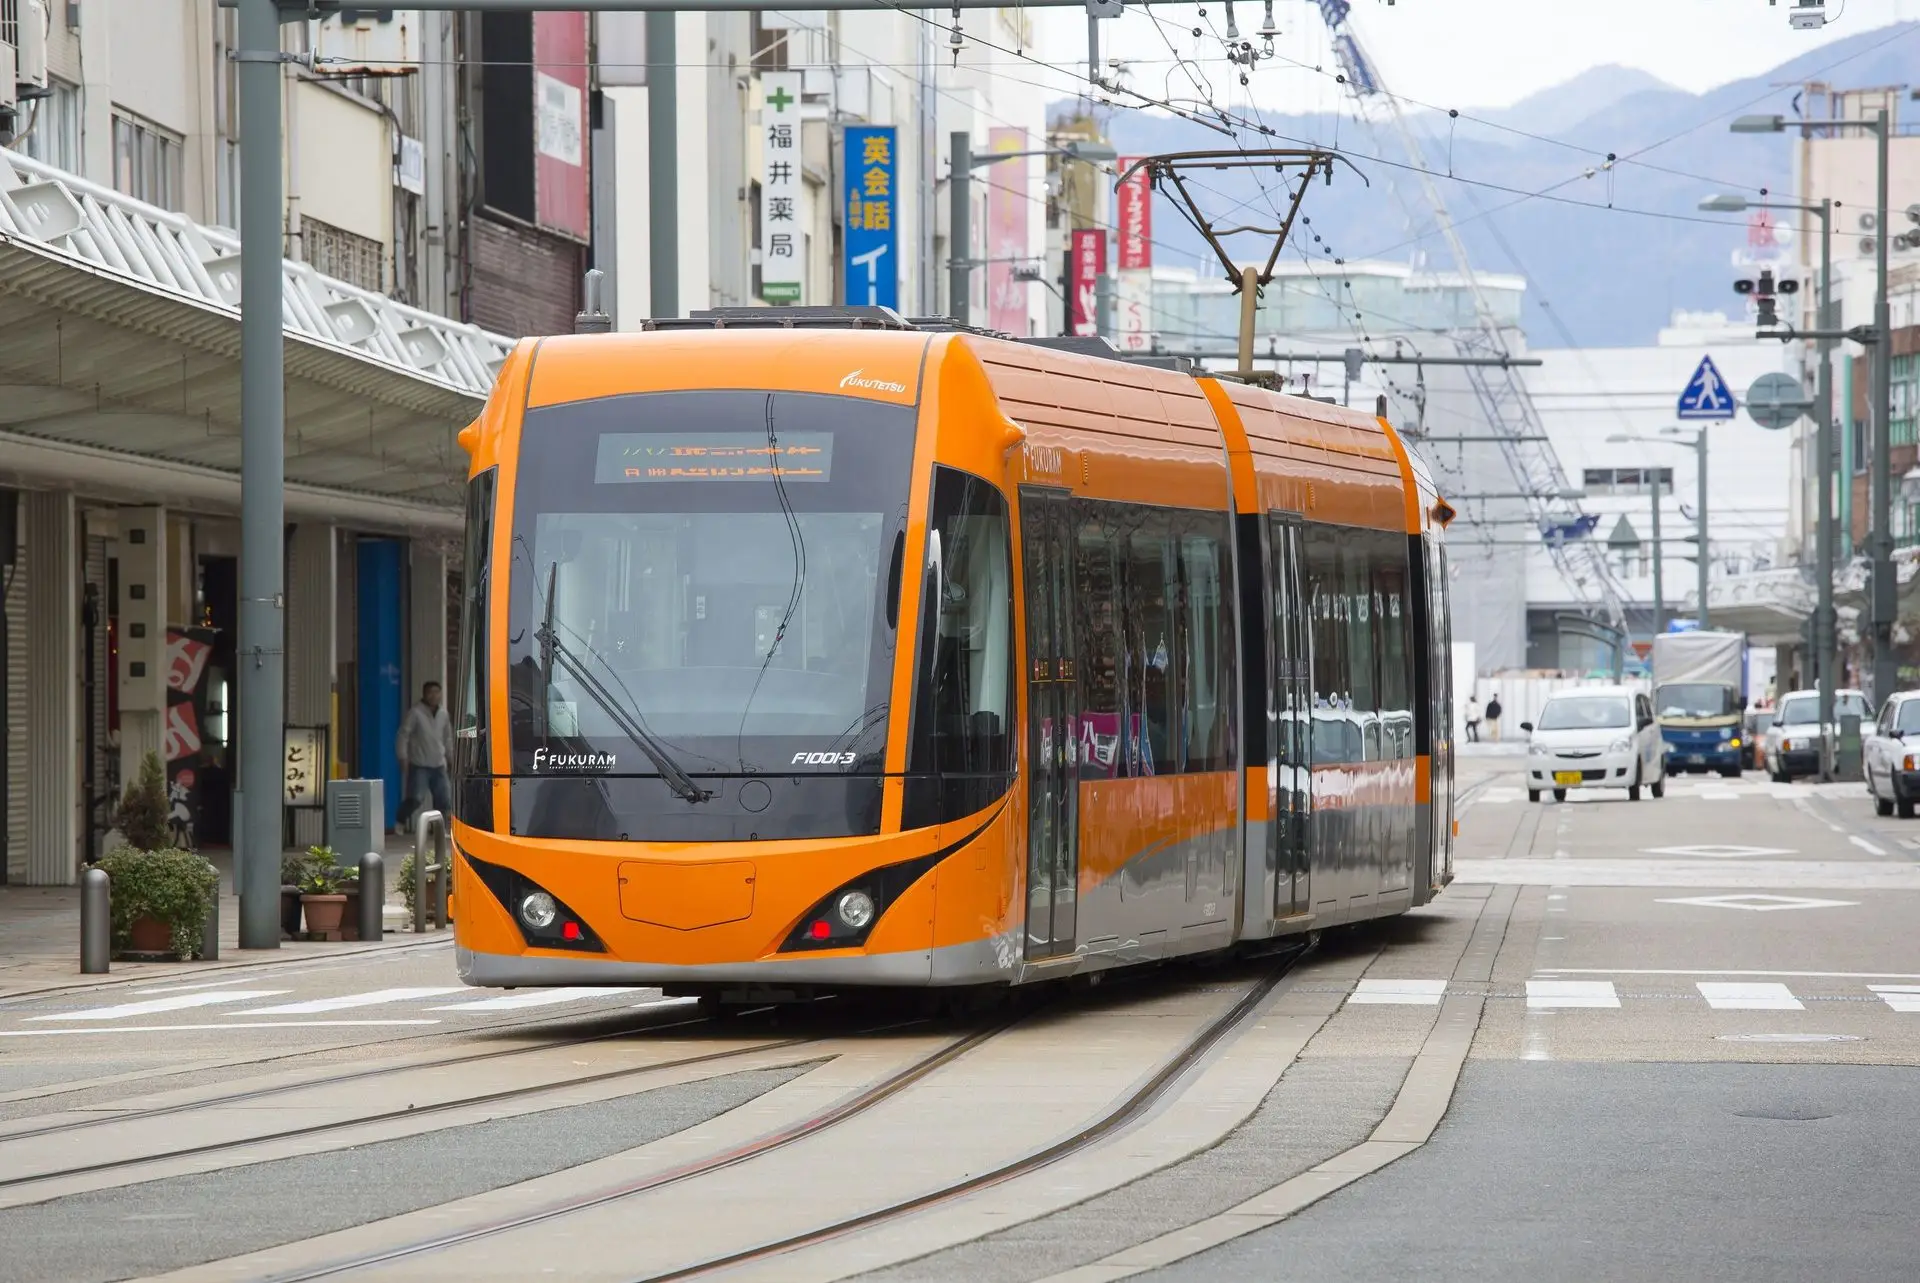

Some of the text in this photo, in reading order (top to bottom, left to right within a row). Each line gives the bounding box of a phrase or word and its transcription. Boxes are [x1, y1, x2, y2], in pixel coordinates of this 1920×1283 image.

[768, 124, 793, 258] 福井薬局
[863, 136, 890, 230] 英会話
[287, 746, 305, 800] とみや
[549, 754, 617, 766] FUKURAM
